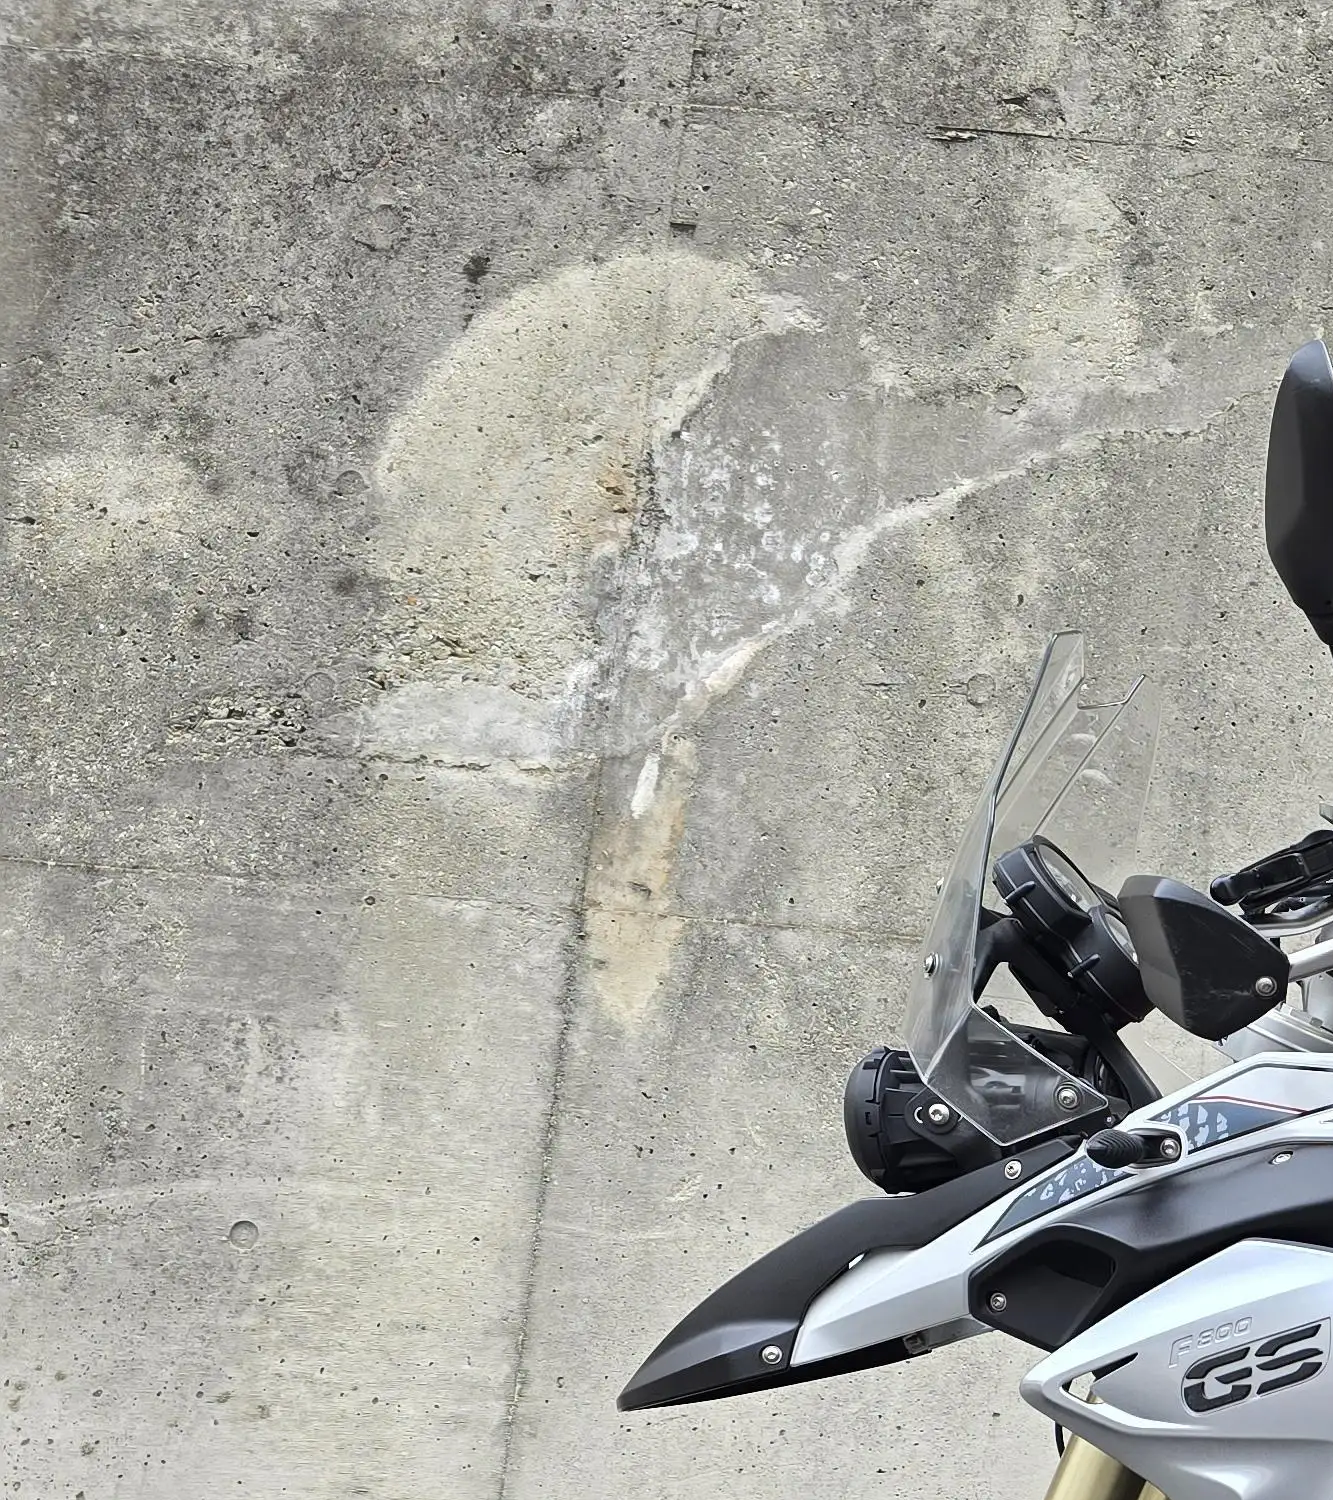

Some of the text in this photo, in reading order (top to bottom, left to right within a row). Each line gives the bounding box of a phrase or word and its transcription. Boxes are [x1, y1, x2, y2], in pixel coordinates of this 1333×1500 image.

[1168, 1316, 1253, 1369] F 800
[1183, 1323, 1324, 1414] GS
